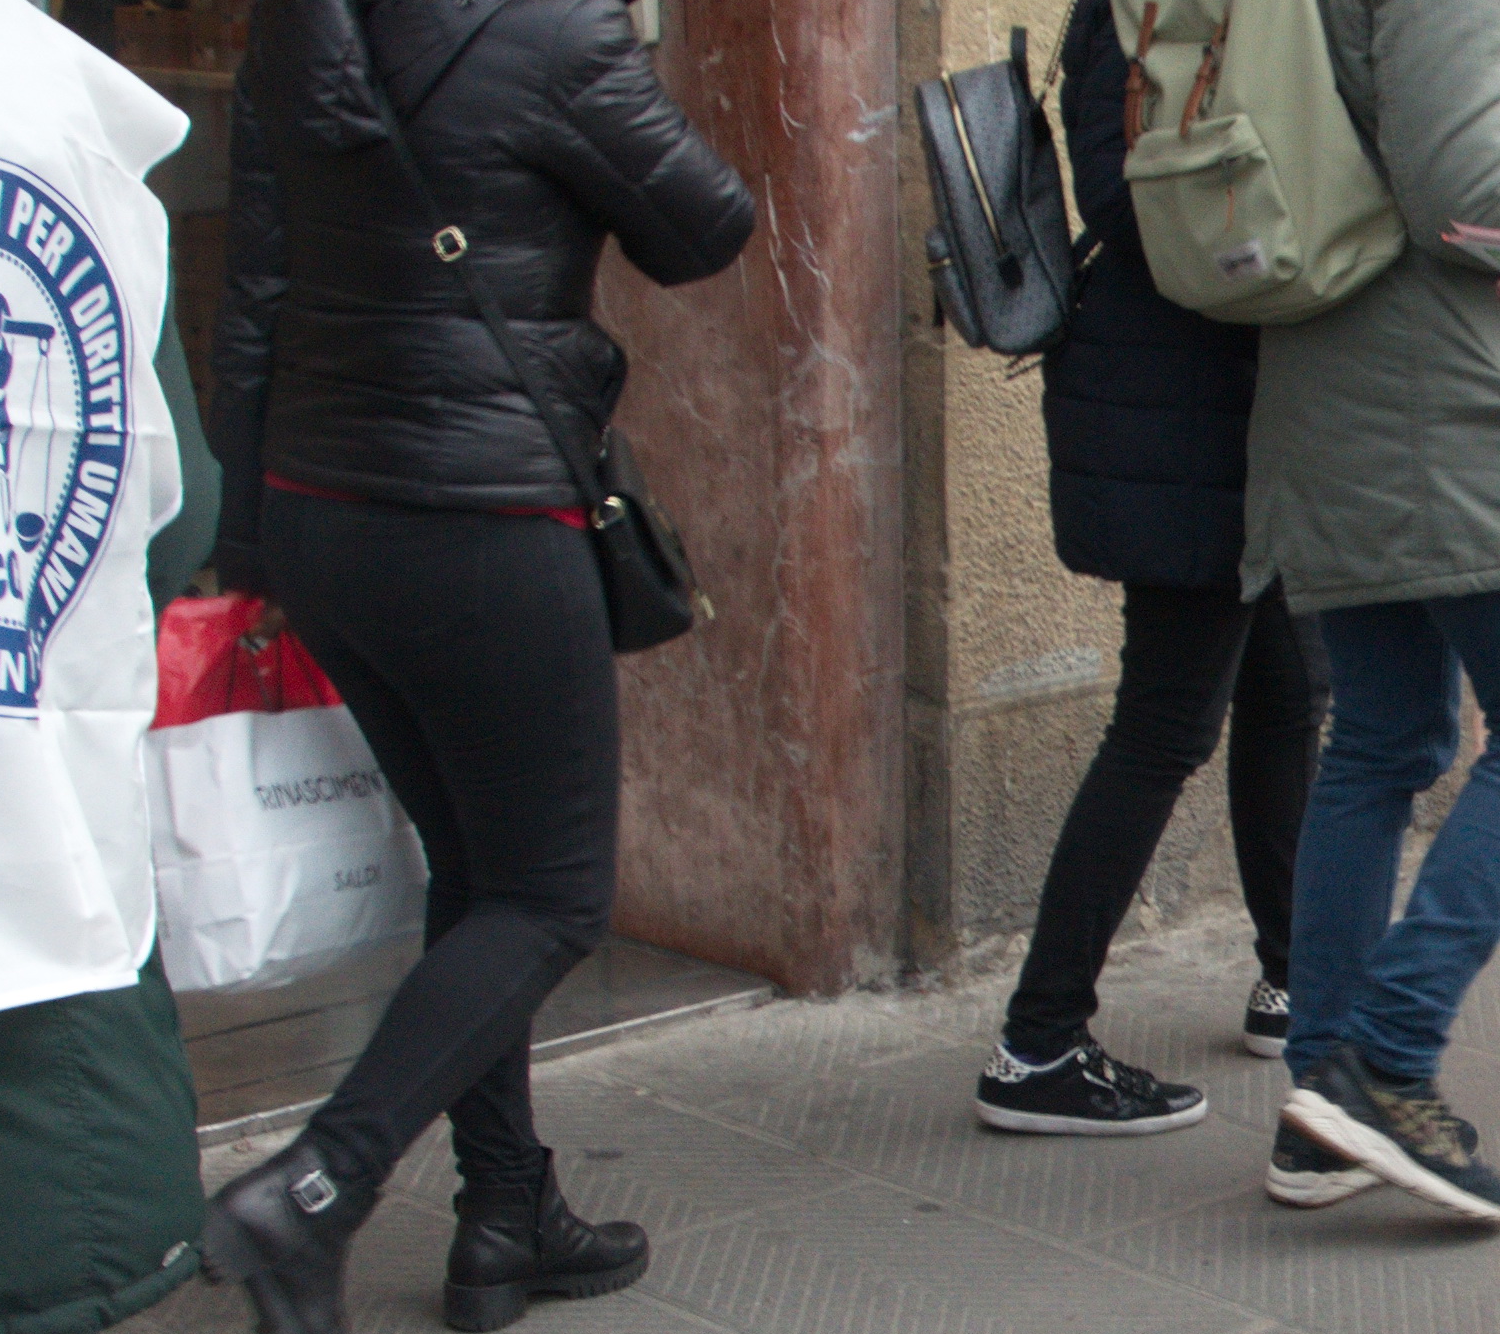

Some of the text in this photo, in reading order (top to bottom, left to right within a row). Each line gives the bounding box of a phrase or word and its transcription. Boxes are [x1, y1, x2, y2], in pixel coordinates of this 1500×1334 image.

[7, 187, 76, 276] PER
[62, 262, 93, 297] I
[71, 287, 123, 451] DIRITTI
[40, 462, 119, 618] UMANI
